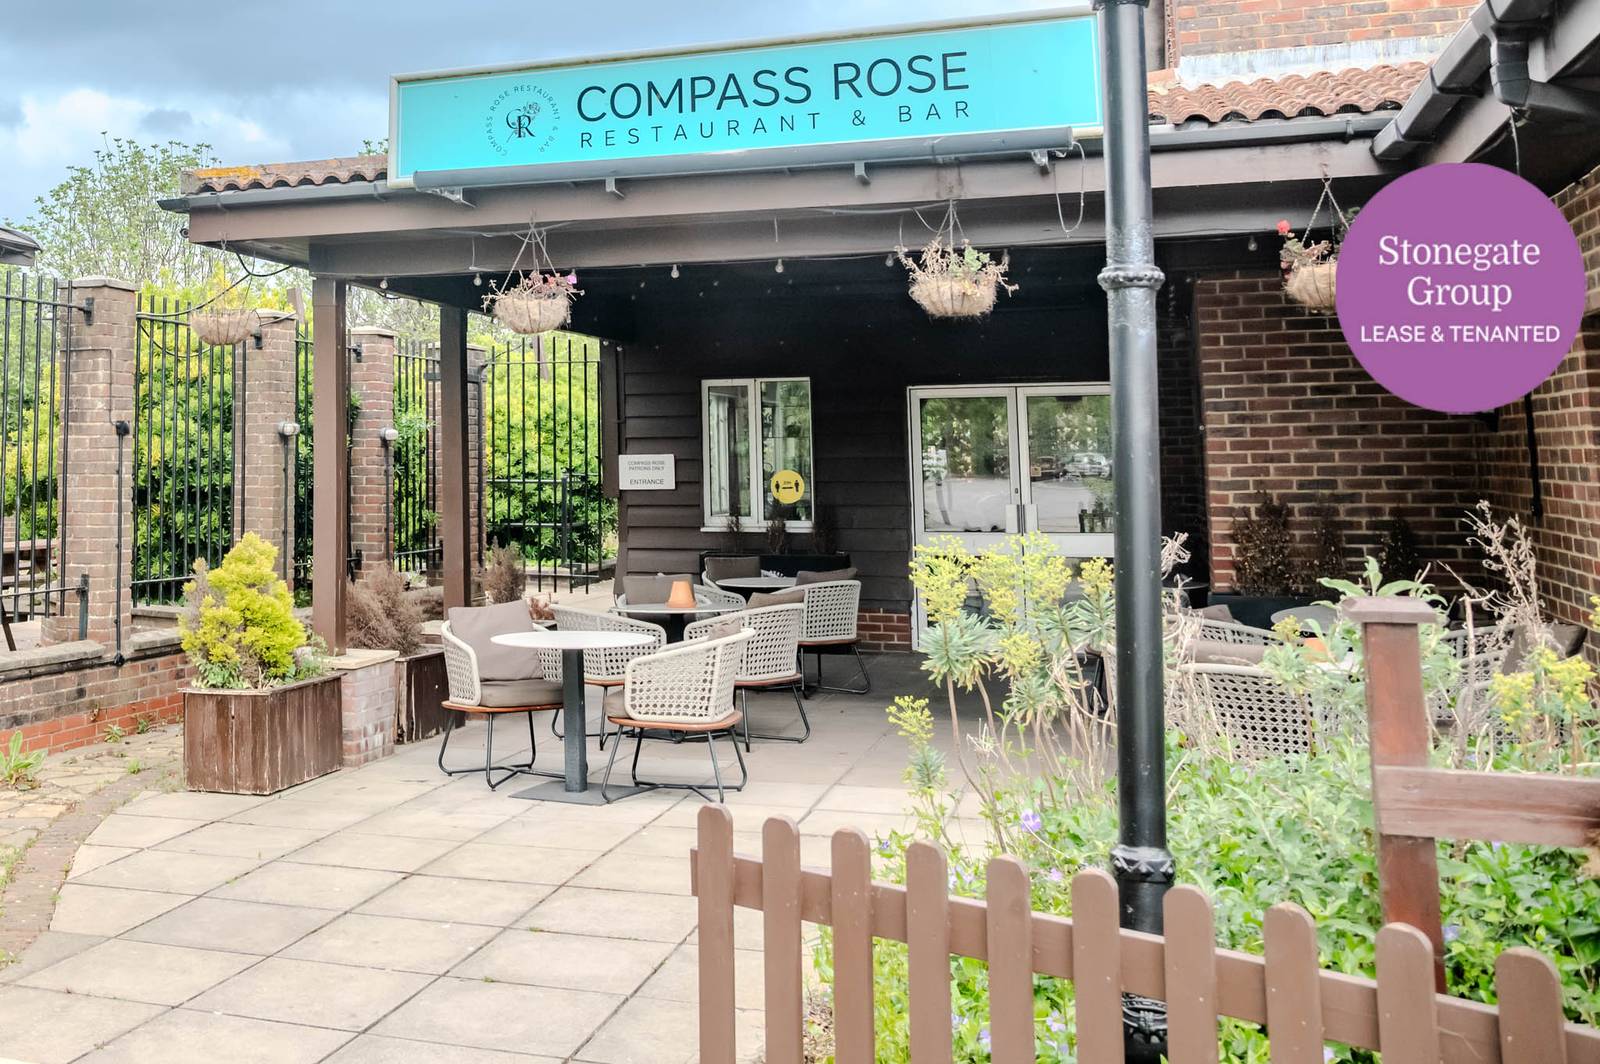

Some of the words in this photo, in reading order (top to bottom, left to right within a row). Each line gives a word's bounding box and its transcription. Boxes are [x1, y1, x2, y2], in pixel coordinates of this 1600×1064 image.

[489, 90, 510, 112] ROSE
[513, 84, 561, 120] RESTAURANT
[577, 66, 812, 122] COMPASS
[833, 51, 970, 100] ROSE
[486, 116, 507, 156] COMPASS
[580, 112, 821, 149] RESTAURANT
[851, 108, 867, 127] &
[898, 100, 970, 123] BAR
